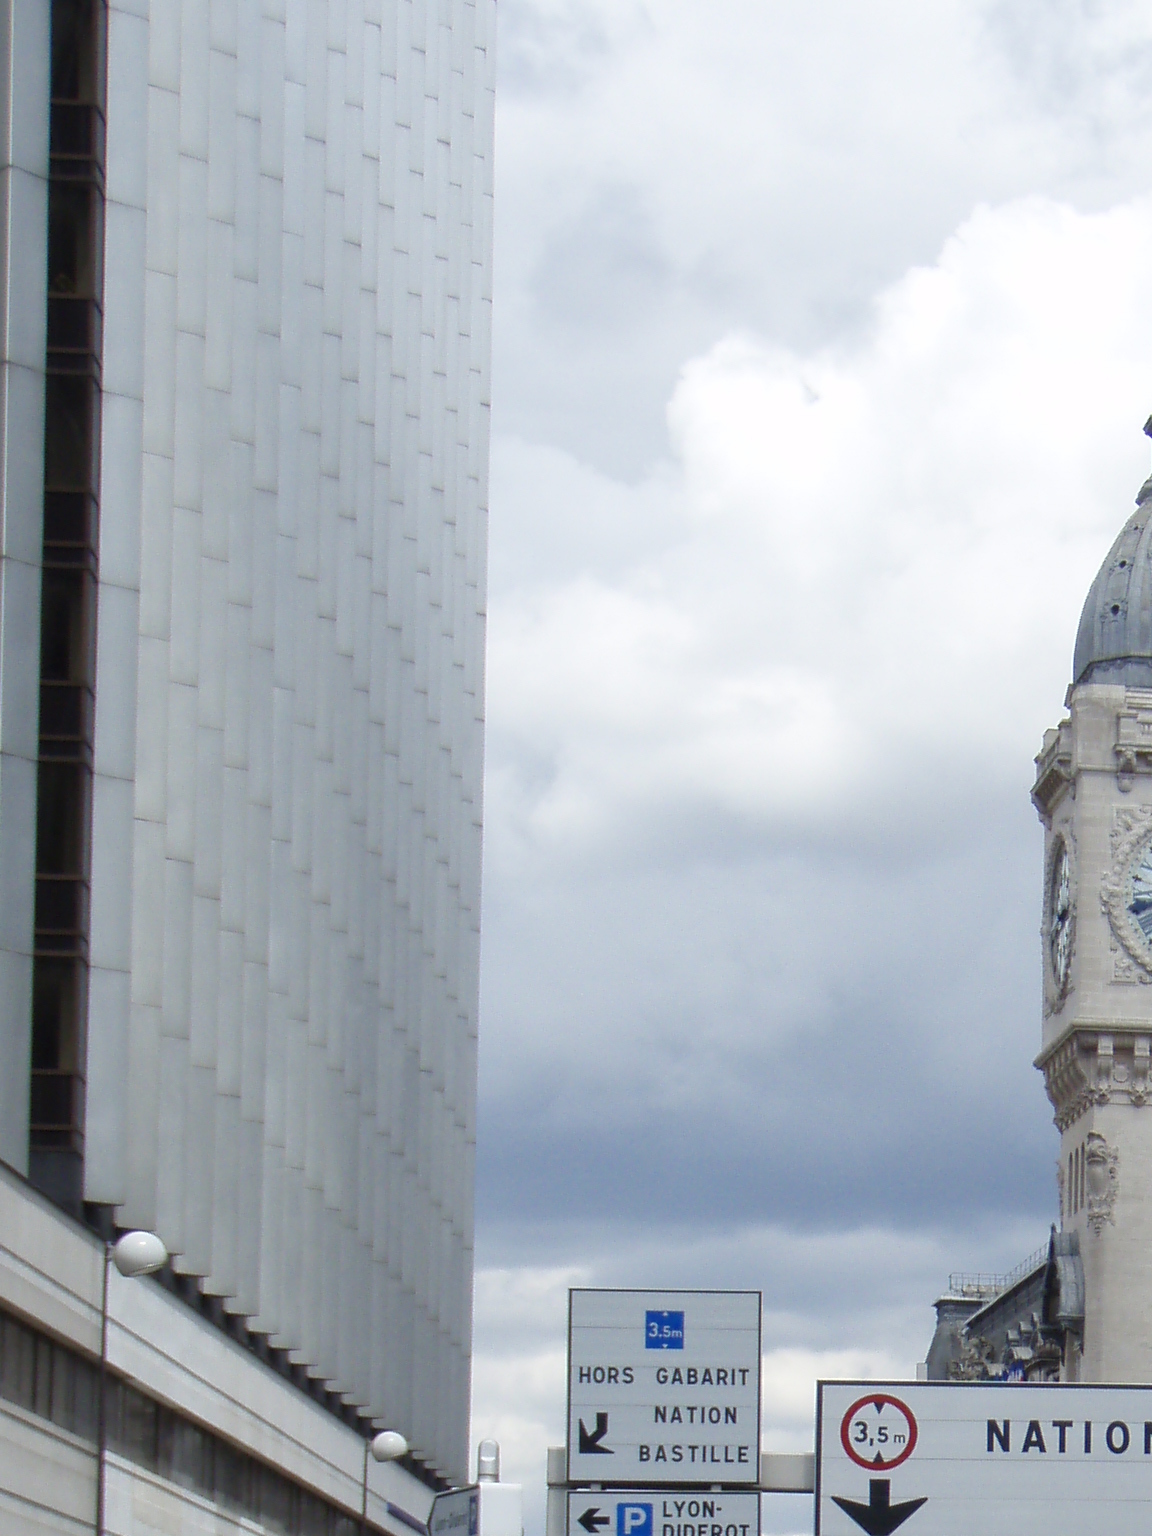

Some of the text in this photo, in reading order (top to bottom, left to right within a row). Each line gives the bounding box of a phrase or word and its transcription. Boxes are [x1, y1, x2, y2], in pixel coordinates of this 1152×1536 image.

[649, 1322, 682, 1338] 3.5m
[579, 1367, 750, 1386] HORS GABARIT
[654, 1406, 738, 1424] NATION
[639, 1445, 750, 1464] BASTILLE
[662, 1500, 723, 1518] LYON-
[624, 1508, 646, 1535] P
